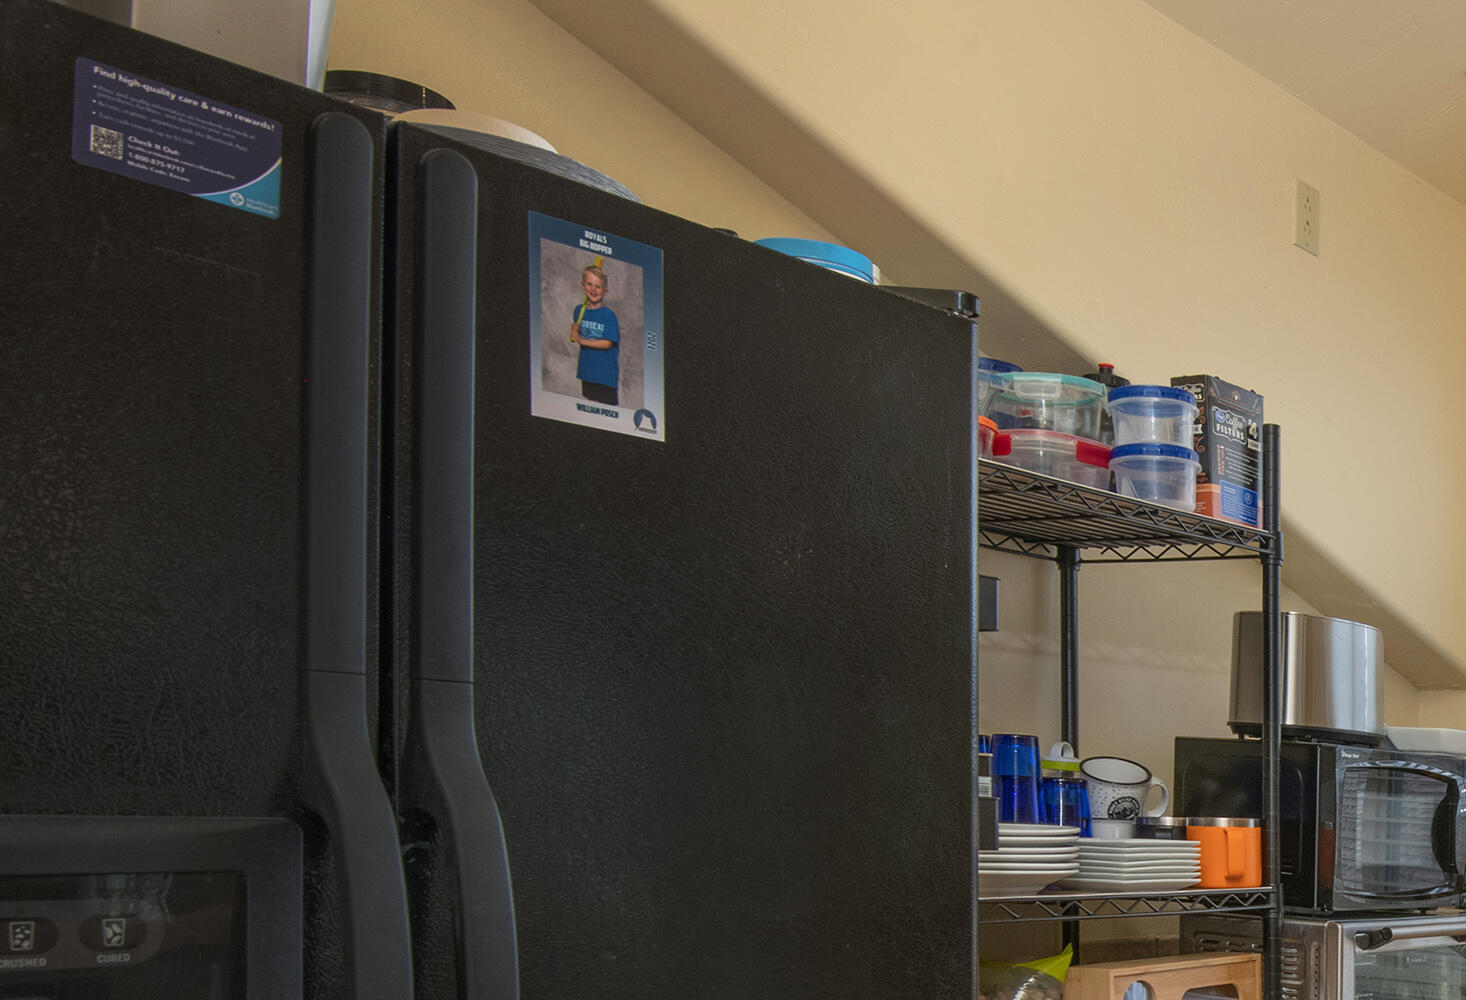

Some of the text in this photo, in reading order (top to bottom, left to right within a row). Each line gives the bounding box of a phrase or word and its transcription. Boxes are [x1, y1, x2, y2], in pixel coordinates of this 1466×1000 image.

[94, 66, 275, 132] Find high-quality care & earn rewards!
[128, 136, 152, 148] Check
[585, 230, 608, 244] ROYALS
[1225, 412, 1245, 431] Coffee
[1216, 423, 1245, 441] FILTERS
[97, 953, 130, 964] CUBED
